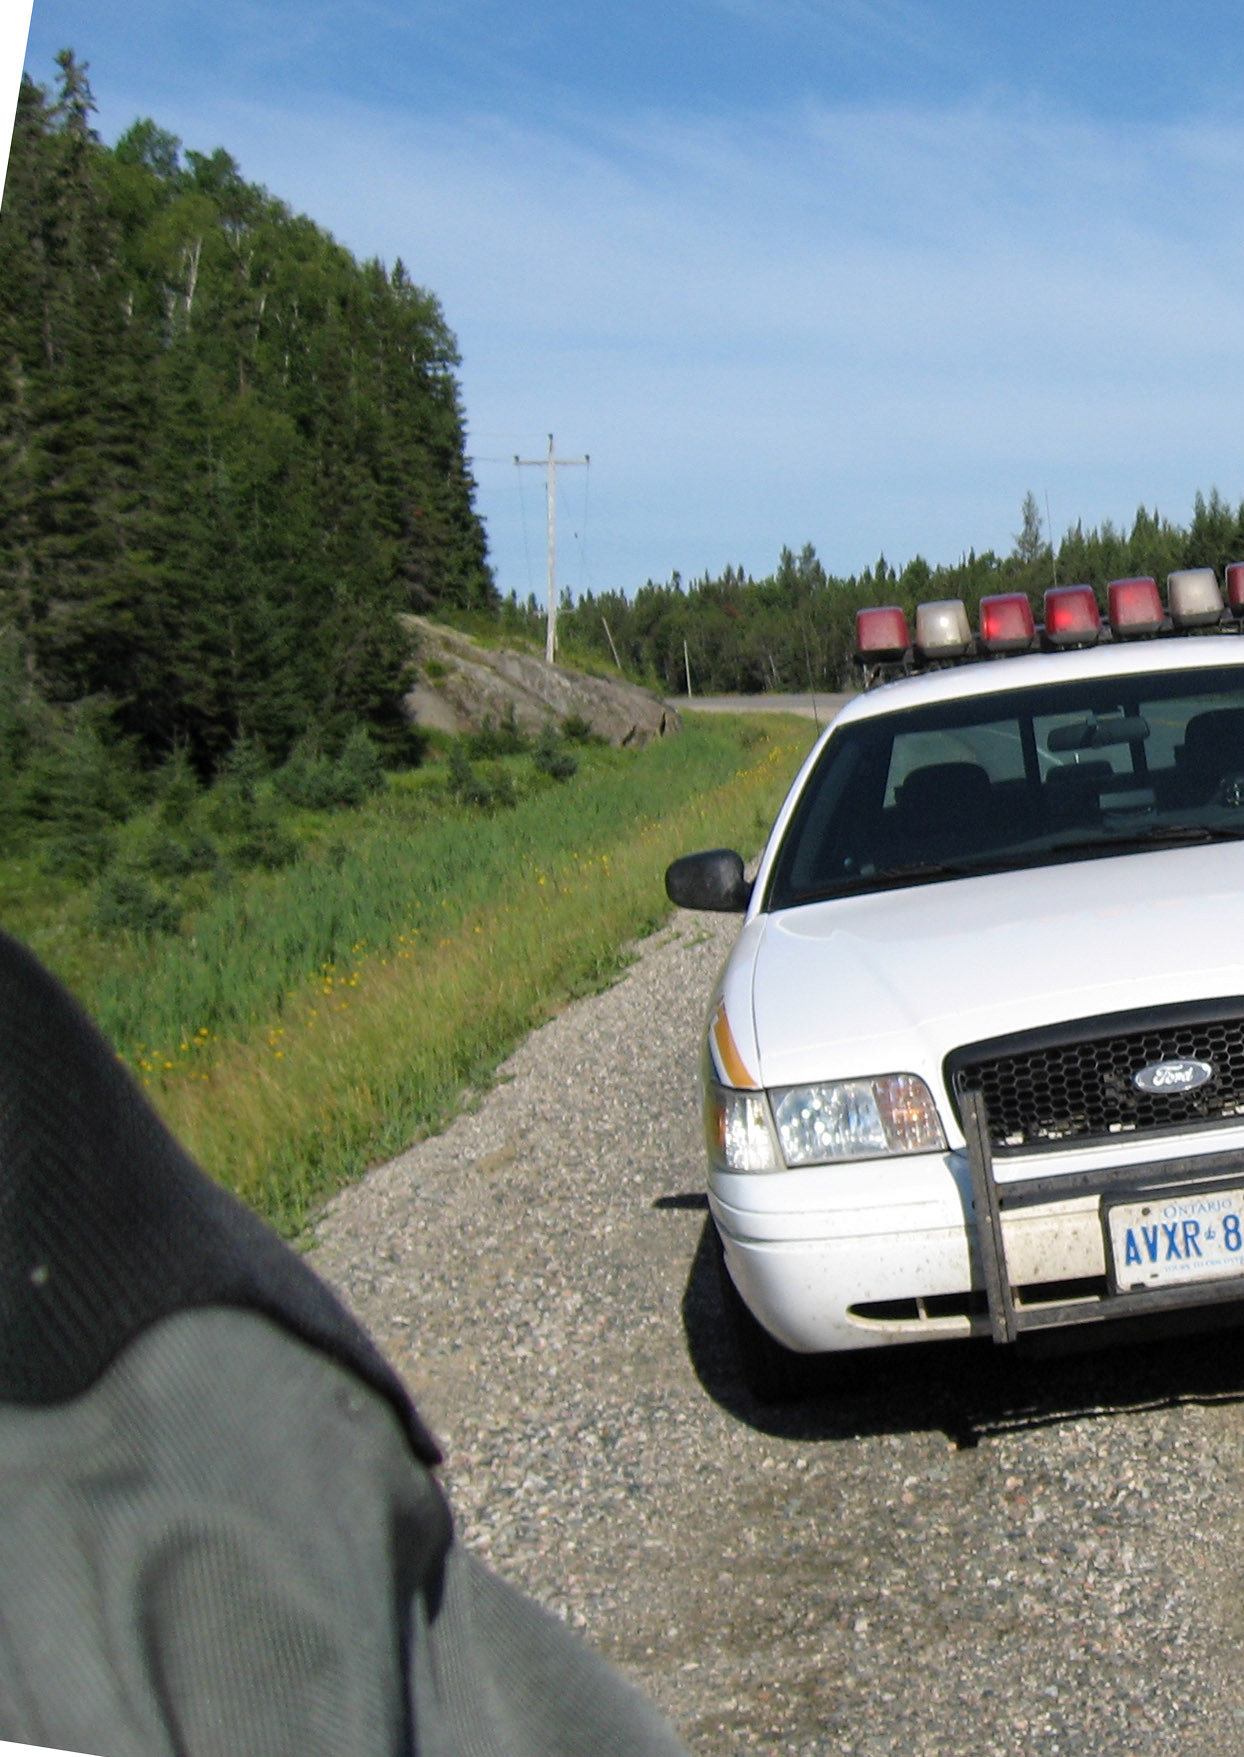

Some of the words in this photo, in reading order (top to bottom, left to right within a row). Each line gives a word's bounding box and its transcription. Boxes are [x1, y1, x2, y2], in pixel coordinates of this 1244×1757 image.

[1152, 1064, 1193, 1086] Ford
[1163, 1199, 1233, 1219] ONTARIO
[1125, 1219, 1203, 1267] AVXR
